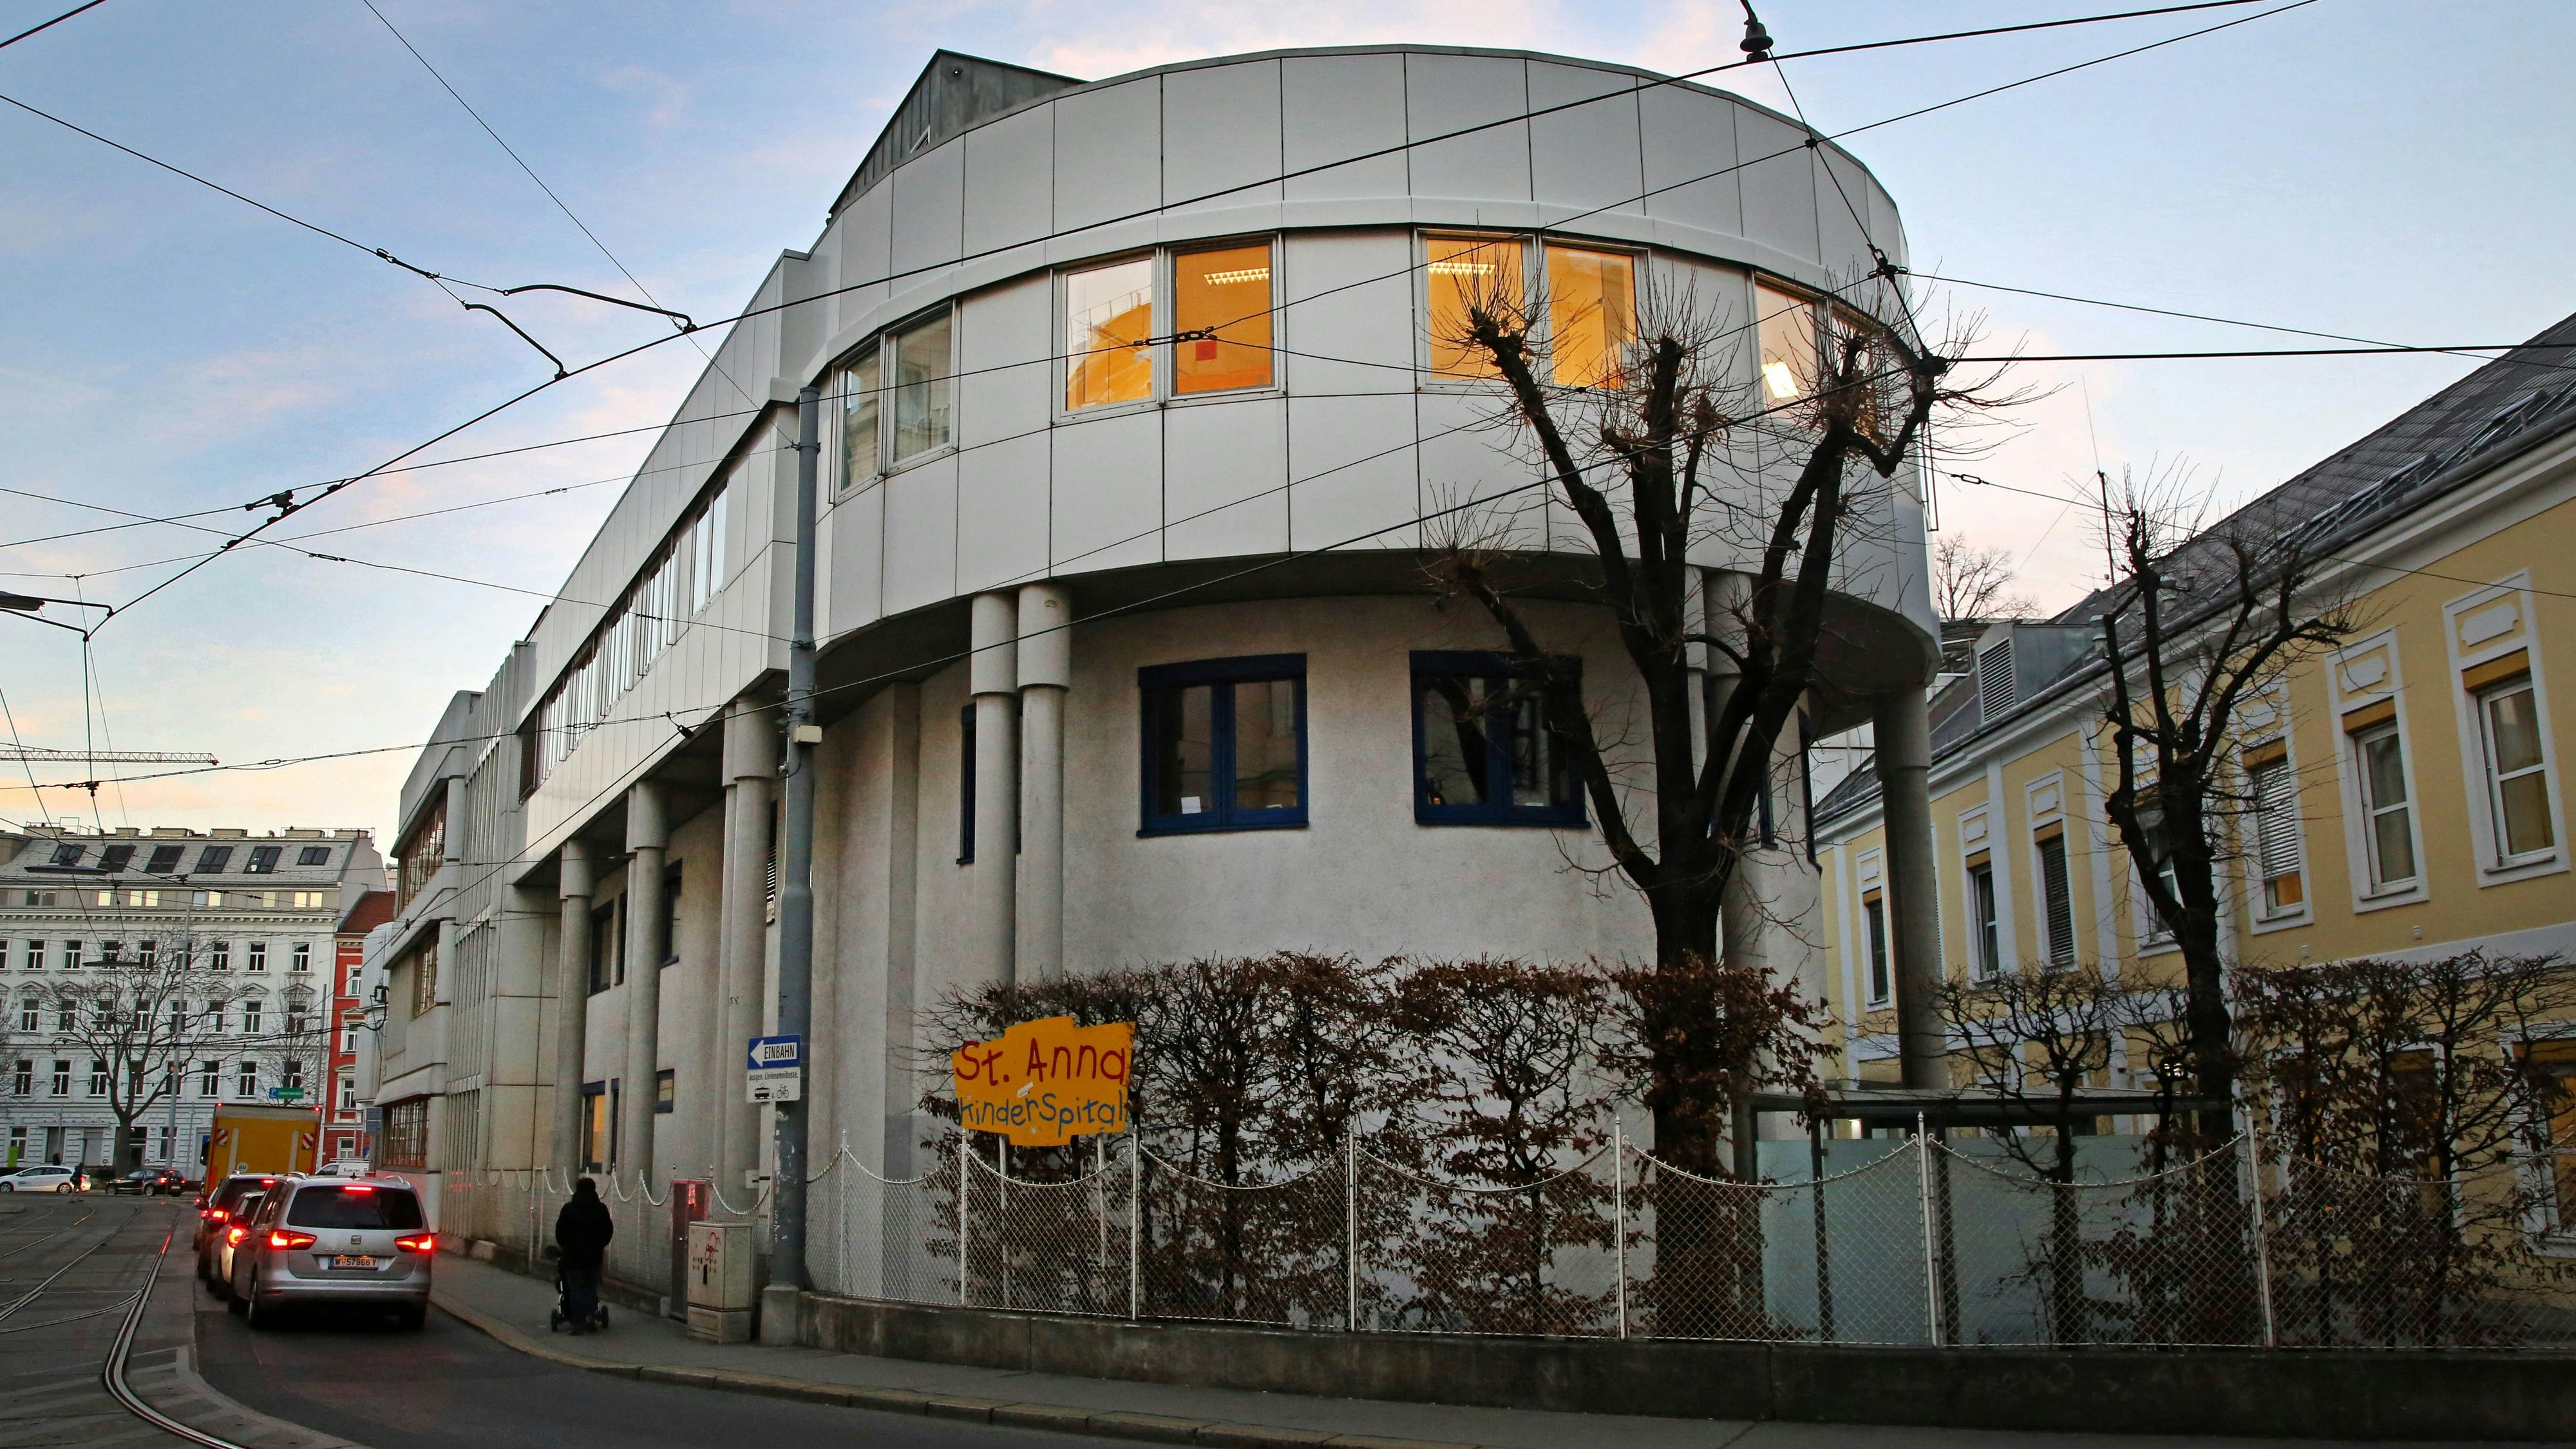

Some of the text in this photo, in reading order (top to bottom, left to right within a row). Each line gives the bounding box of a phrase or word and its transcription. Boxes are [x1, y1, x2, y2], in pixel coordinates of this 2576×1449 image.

[764, 1045, 795, 1059] EINBAHN
[956, 1037, 1126, 1086] St. Anna
